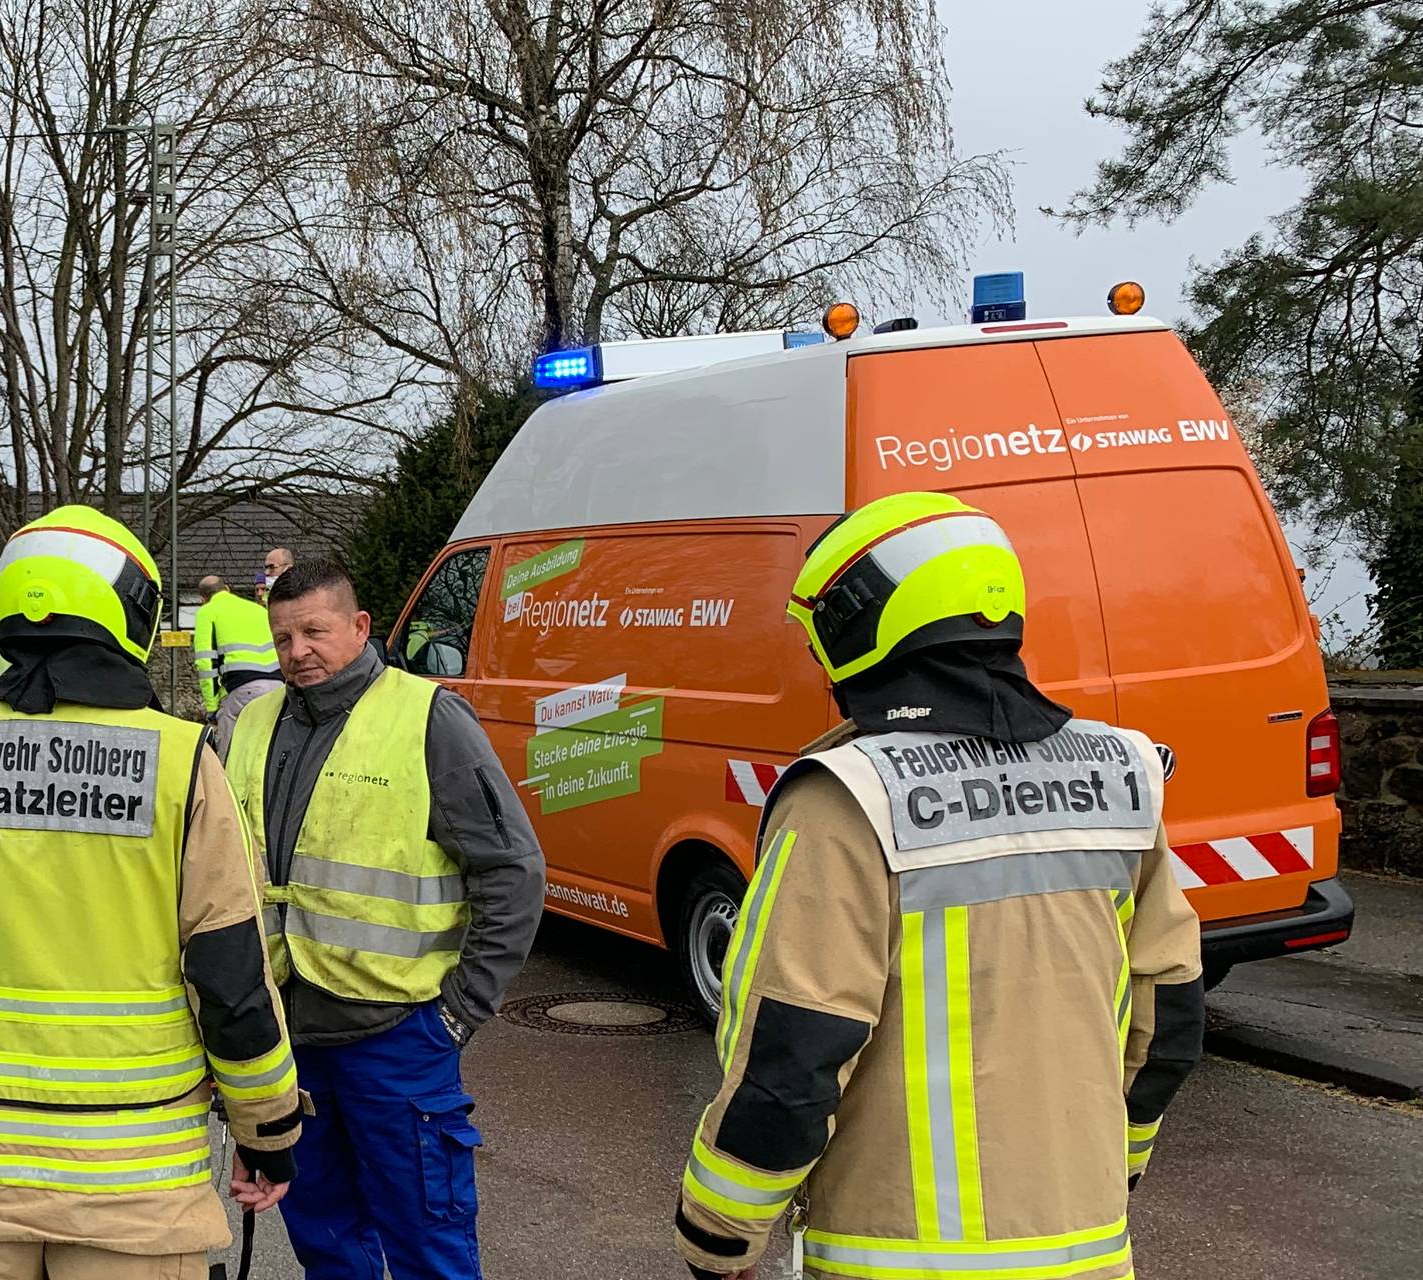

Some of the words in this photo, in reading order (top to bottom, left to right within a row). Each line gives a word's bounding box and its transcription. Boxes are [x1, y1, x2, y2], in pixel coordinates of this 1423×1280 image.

[875, 424, 1067, 471] Regionetz
[1095, 428, 1173, 448] STAWAG
[1177, 420, 1229, 442] EWV
[506, 570, 530, 589] Deine
[530, 549, 579, 579] Ausbildung
[507, 597, 521, 616] bei
[519, 591, 609, 636] Regionetz
[634, 608, 684, 627] STAWAG
[689, 599, 735, 627] EWV
[541, 707, 553, 722] Du
[554, 696, 586, 717] kannst
[887, 706, 932, 720] Dräger
[47, 737, 146, 783] Stolberg
[534, 745, 567, 769] Stecke
[570, 737, 601, 758] deine
[604, 721, 647, 749] Energie
[338, 772, 390, 786] regionetz
[545, 782, 555, 800] in
[557, 775, 585, 796] deine
[587, 761, 633, 790] Zukunft.
[907, 770, 1109, 830] C-Dienst
[1123, 771, 1141, 811] 1
